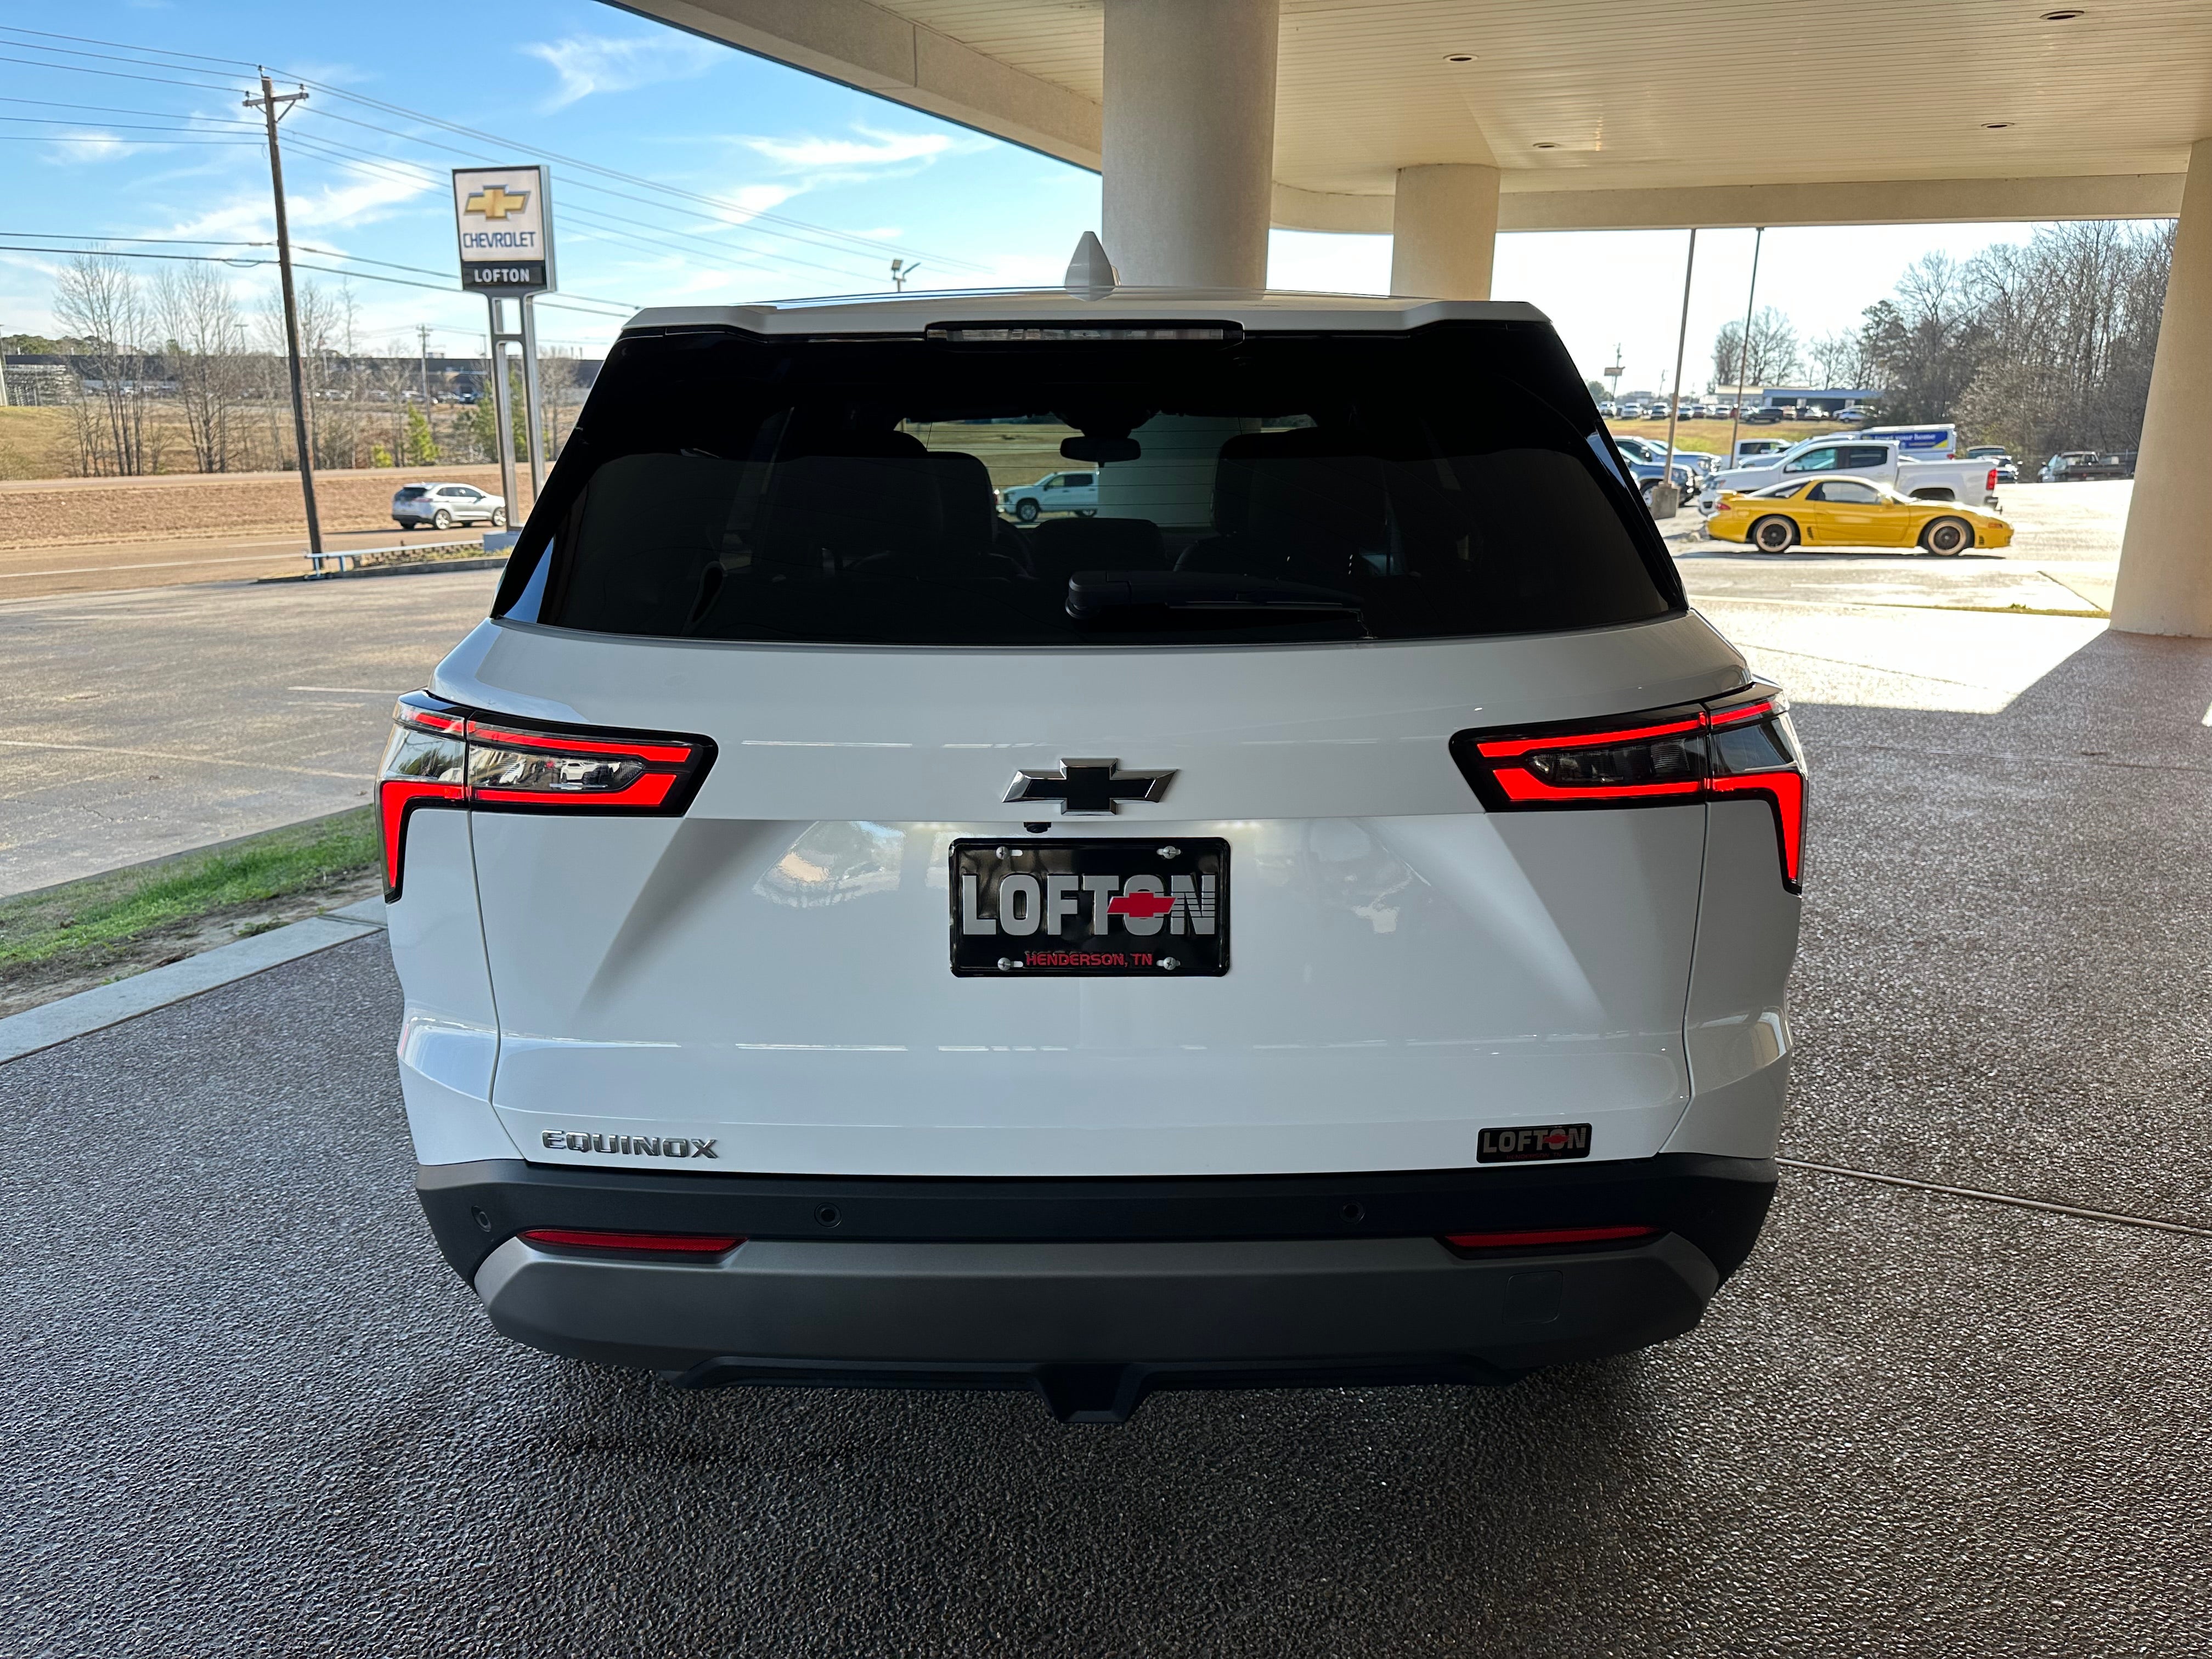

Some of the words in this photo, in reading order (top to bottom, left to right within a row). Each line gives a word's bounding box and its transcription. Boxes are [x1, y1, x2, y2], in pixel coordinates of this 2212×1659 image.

[462, 231, 536, 249] CHEVROLET
[474, 268, 530, 283] LOFTON
[962, 874, 1216, 936] LOFTON
[1026, 952, 1128, 967] HENDERSON,
[1131, 952, 1153, 966] TN
[541, 1129, 719, 1159] EQUINOX
[1483, 1127, 1587, 1153] LOFTON
